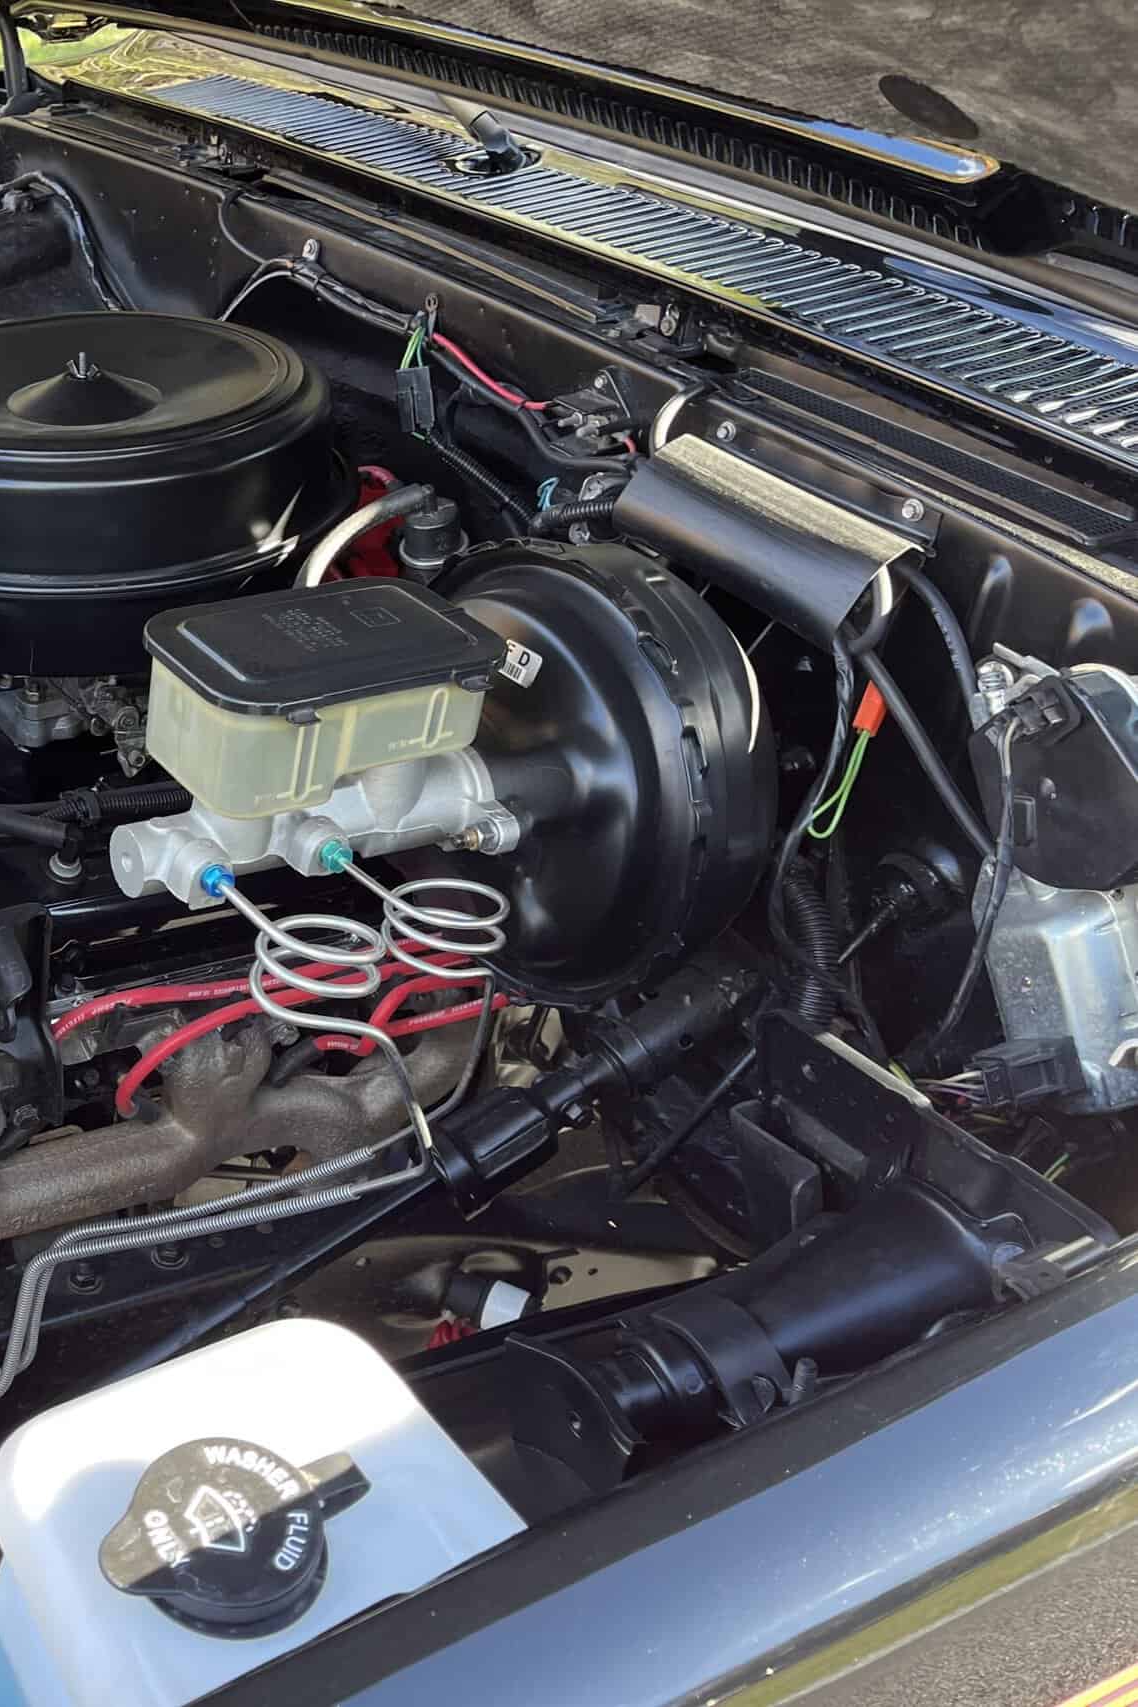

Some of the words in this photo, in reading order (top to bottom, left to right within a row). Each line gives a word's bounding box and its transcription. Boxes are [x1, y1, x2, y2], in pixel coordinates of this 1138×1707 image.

[518, 651, 531, 667] D
[203, 1445, 301, 1501] WASHER
[143, 1509, 191, 1569] ONLY
[273, 1511, 309, 1571] FLUID
